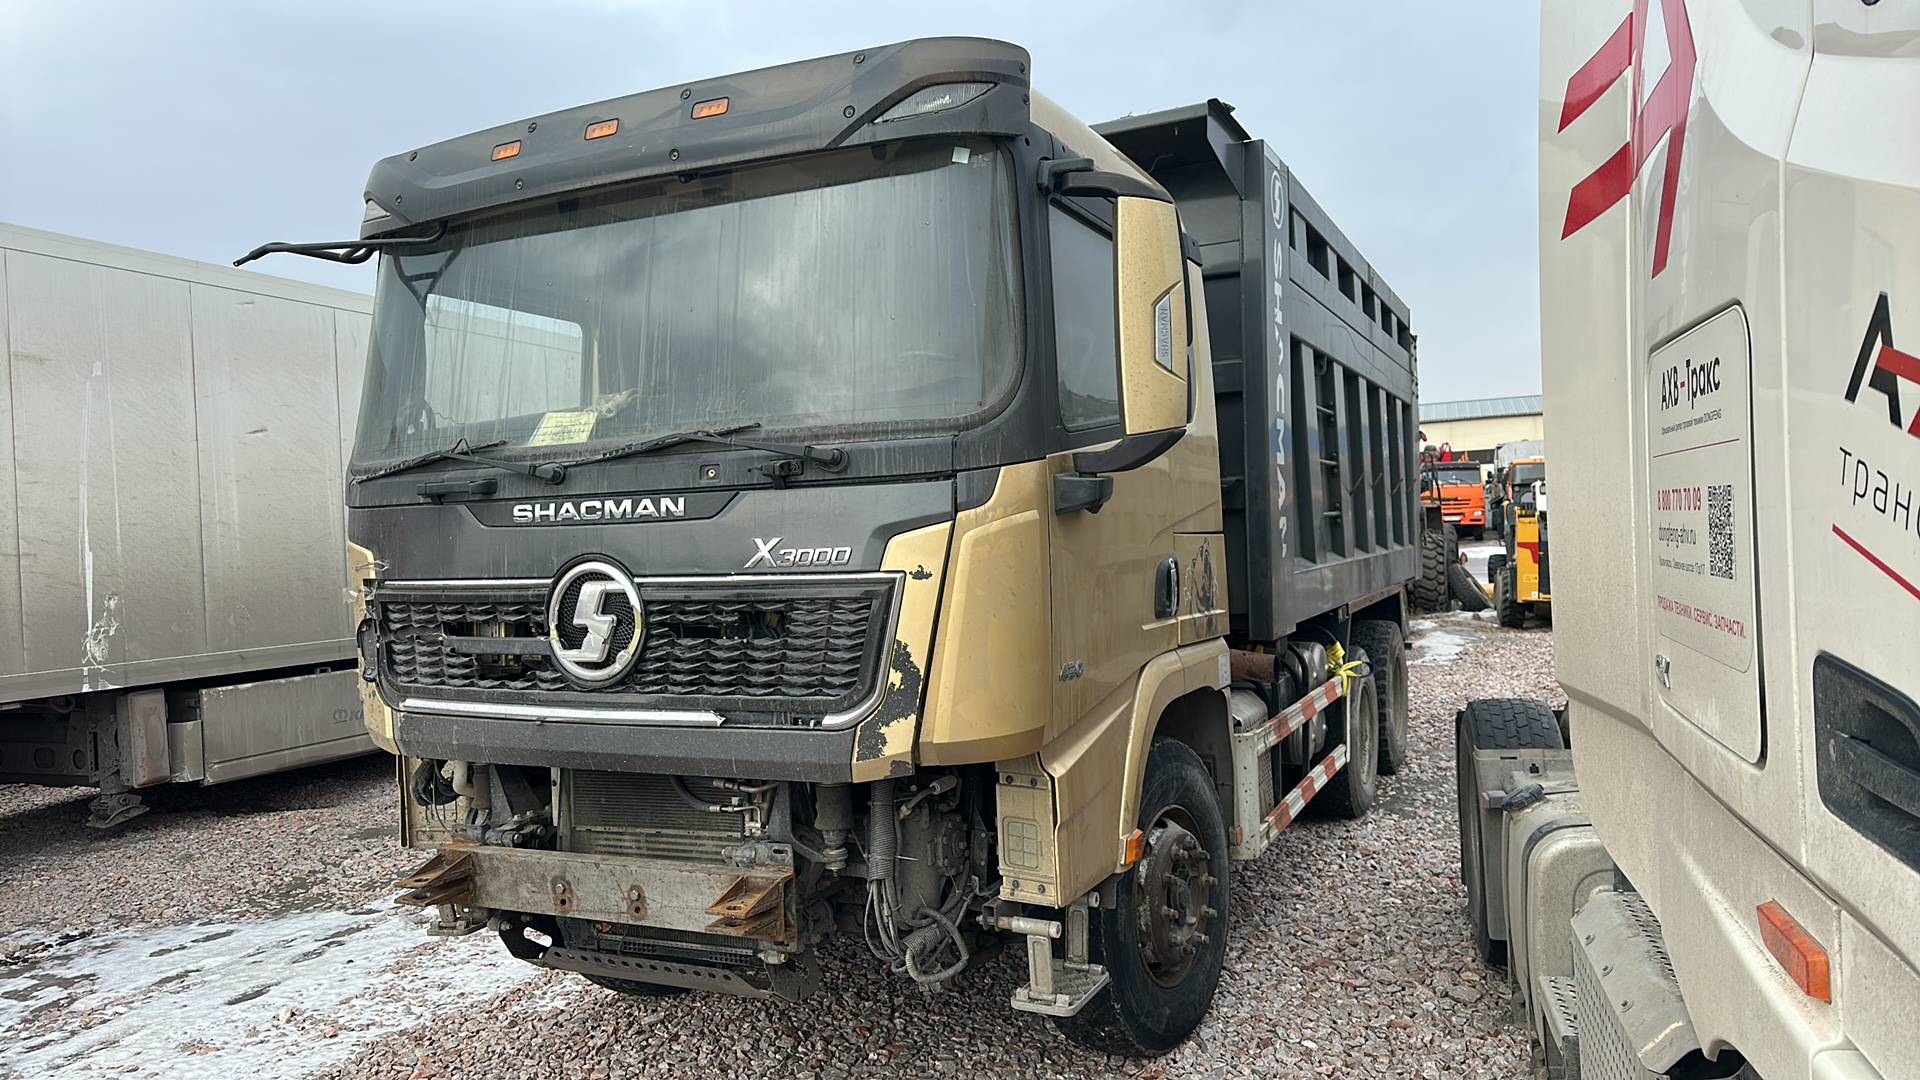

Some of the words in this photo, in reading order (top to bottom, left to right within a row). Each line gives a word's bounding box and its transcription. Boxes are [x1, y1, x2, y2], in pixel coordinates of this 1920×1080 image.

[1839, 446, 1920, 539] тран
[513, 496, 686, 523] SHACMAN
[743, 536, 852, 568] X3000
